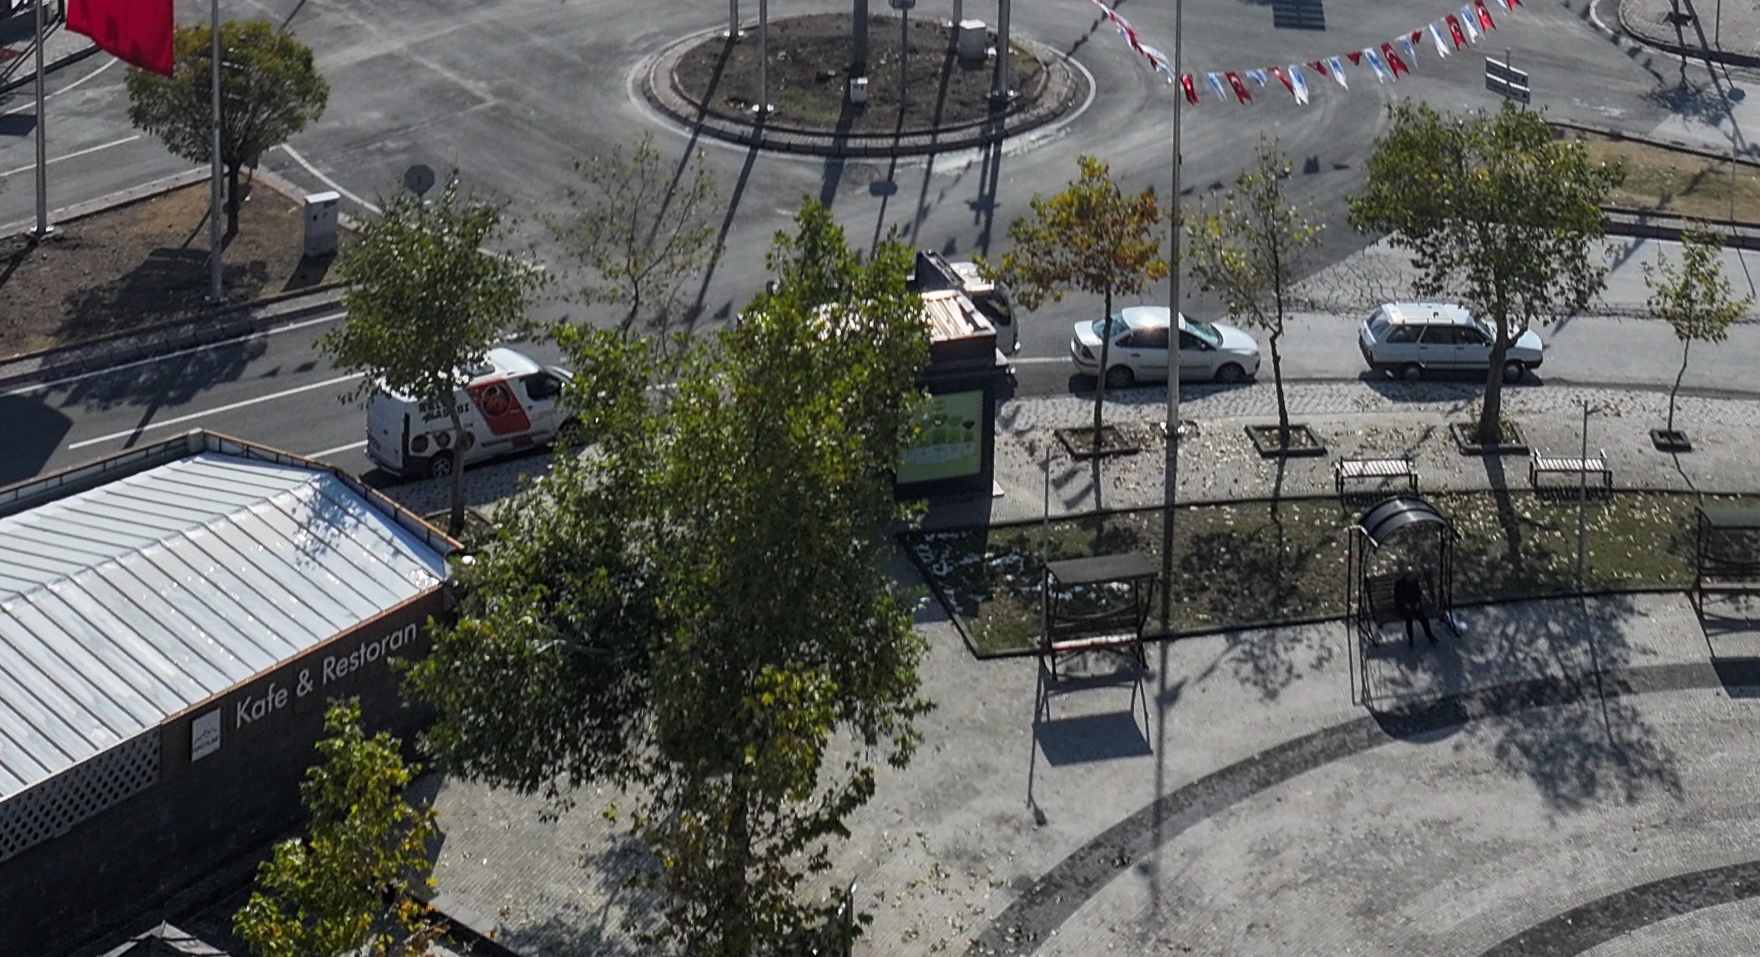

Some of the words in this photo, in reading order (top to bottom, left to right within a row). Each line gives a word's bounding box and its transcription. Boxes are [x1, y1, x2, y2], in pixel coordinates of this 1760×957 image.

[236, 682, 288, 728] Kafe
[296, 668, 314, 697] &
[323, 622, 417, 686] Restoran
